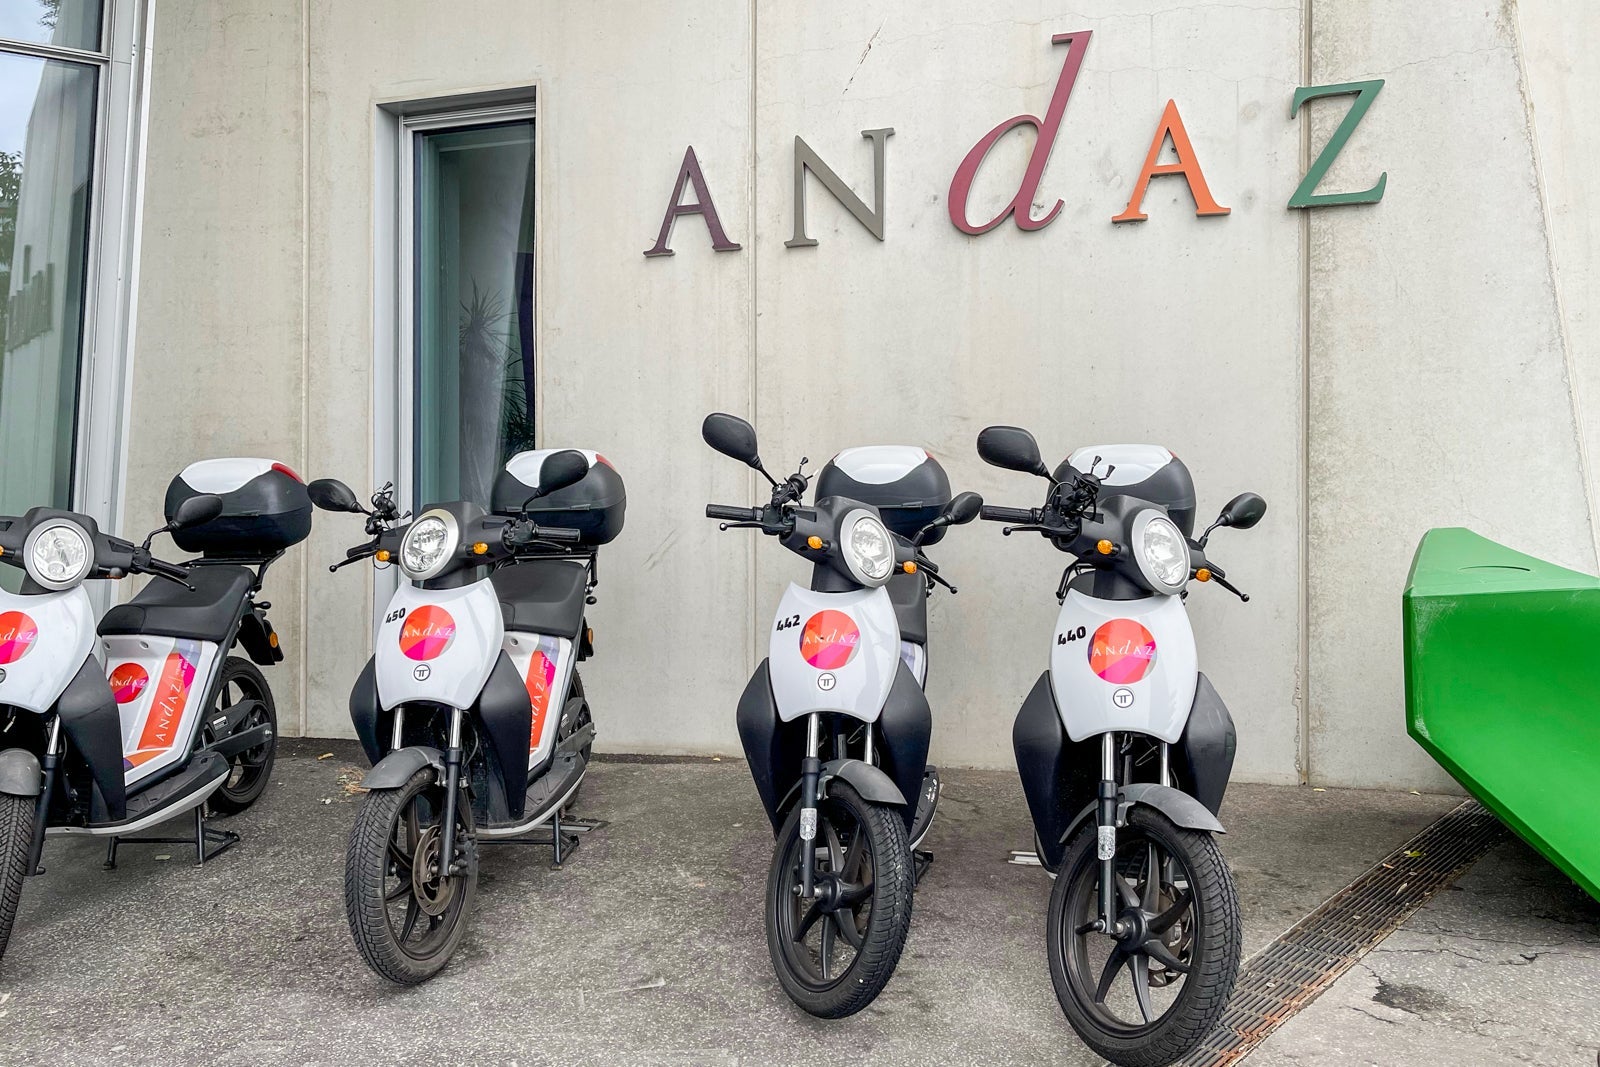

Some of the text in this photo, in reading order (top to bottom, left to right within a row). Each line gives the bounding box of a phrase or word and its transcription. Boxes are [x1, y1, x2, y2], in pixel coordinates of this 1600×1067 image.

[385, 607, 406, 623] 450
[776, 615, 800, 631] 442
[1057, 626, 1087, 646] 440
